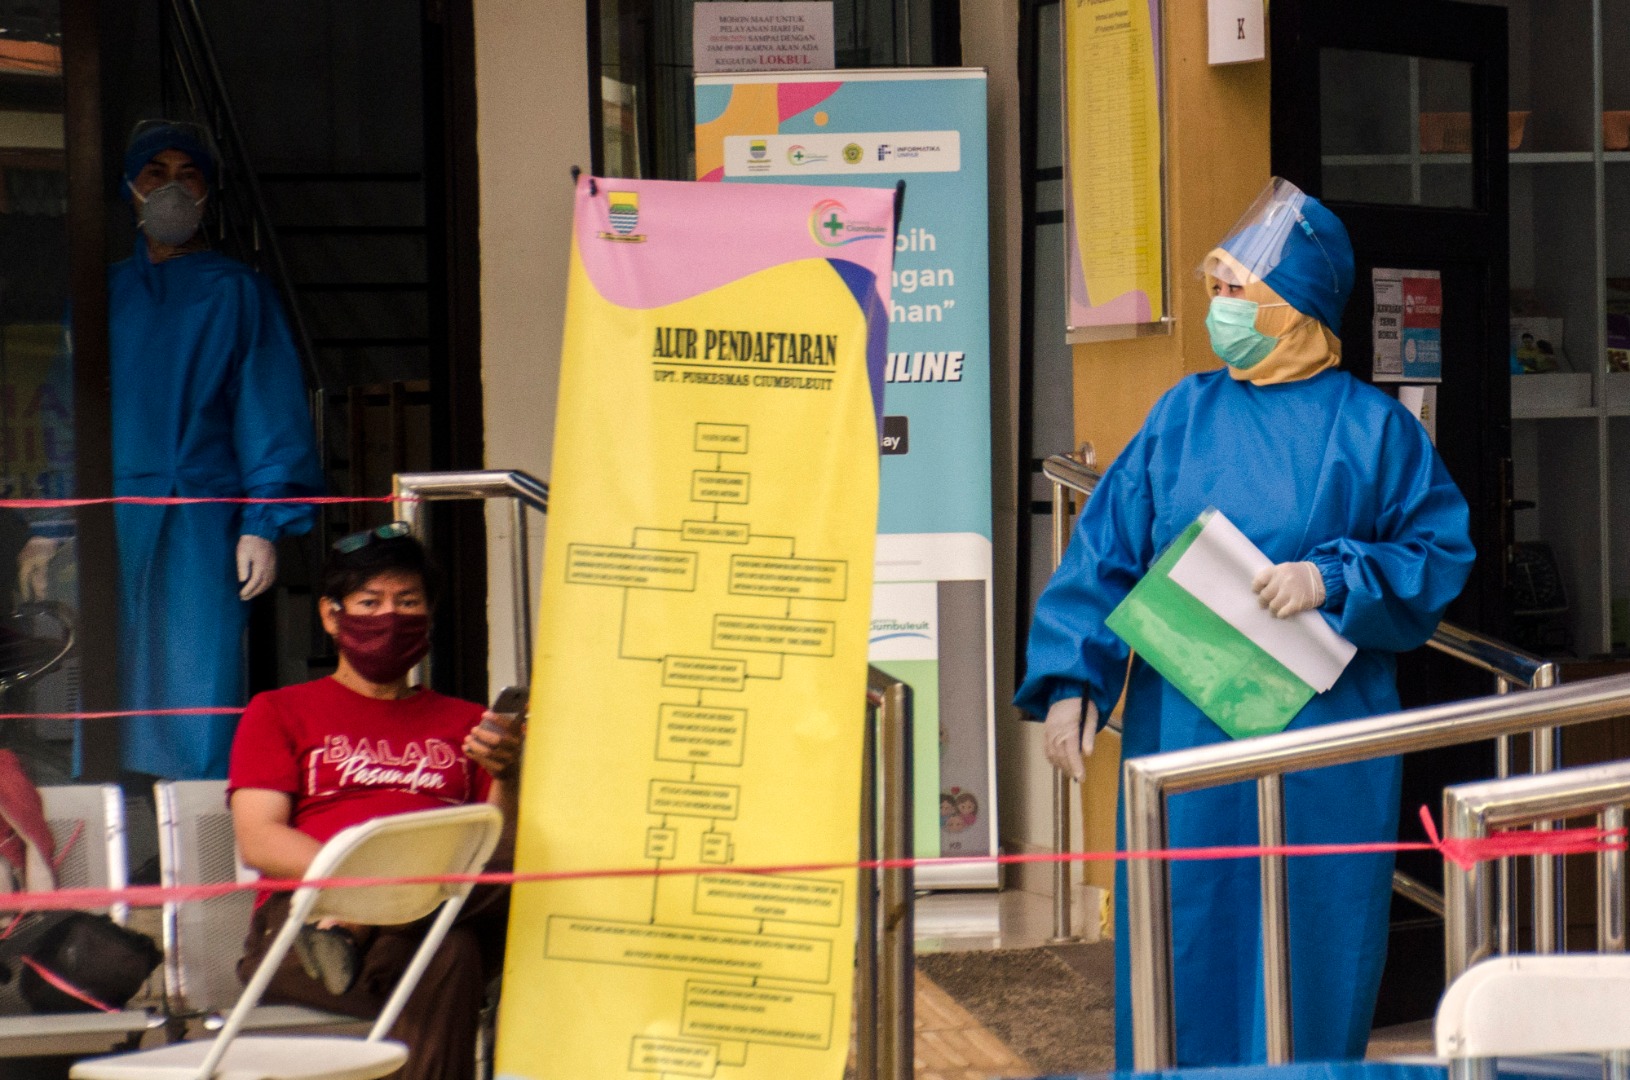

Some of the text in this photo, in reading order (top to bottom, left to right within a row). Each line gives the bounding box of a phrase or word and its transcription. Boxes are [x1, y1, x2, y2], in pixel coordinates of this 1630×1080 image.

[1237, 18, 1246, 39] K
[759, 55, 811, 65] LOKBUL
[652, 326, 838, 367] ALUR PENDAFTARAN
[682, 371, 750, 387] PUSKESMAS
[753, 375, 833, 391] CIUMBULEUIT
[323, 735, 456, 769] BALAD
[335, 755, 446, 790] Pasundan
